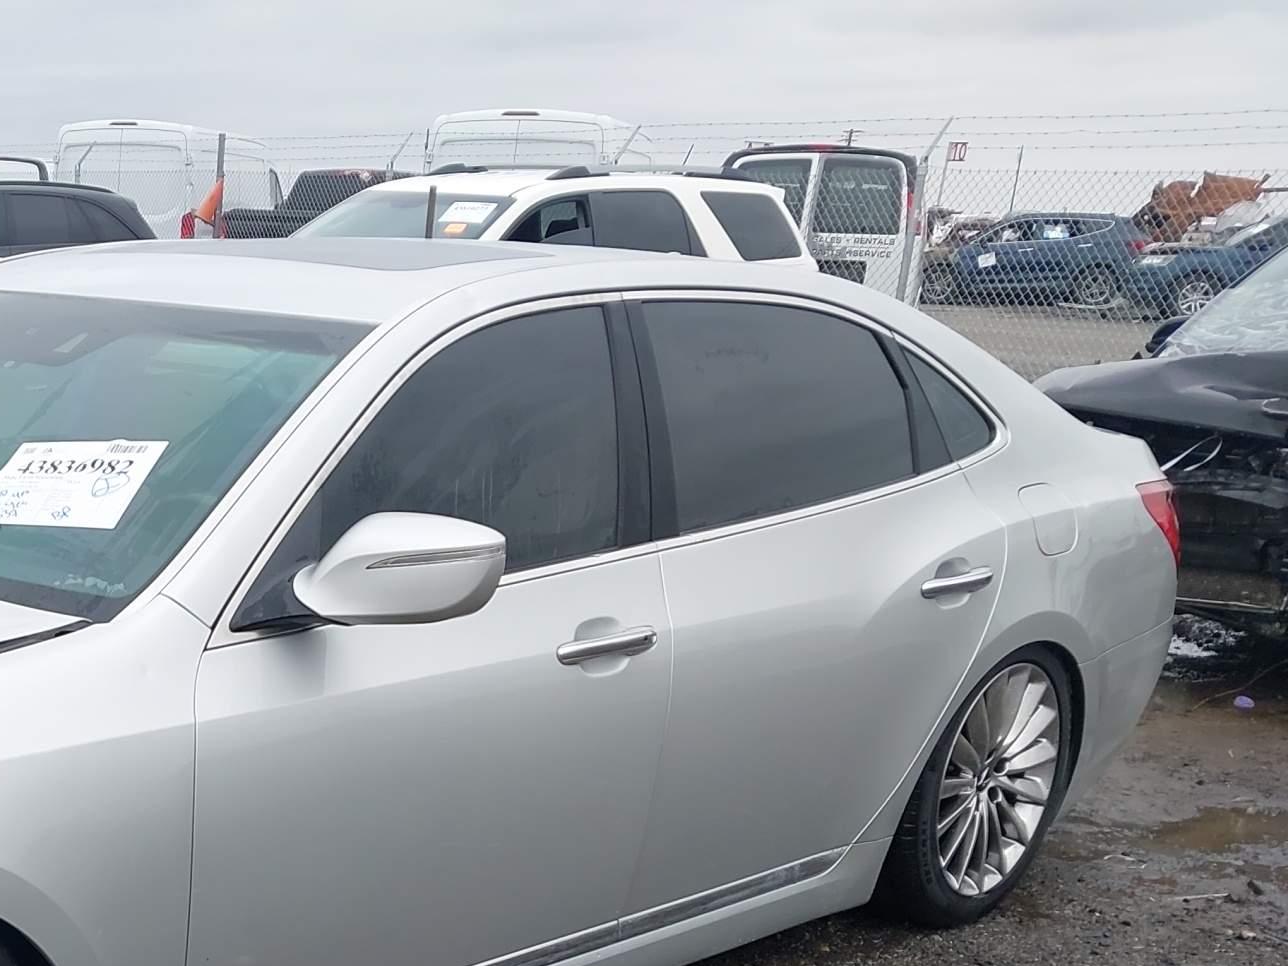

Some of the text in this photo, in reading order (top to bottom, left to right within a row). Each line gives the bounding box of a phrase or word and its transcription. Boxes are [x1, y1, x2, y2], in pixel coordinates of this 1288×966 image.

[853, 238, 896, 246] RENTALS
[853, 249, 893, 258] SERVICE
[17, 458, 134, 475] 43836982
